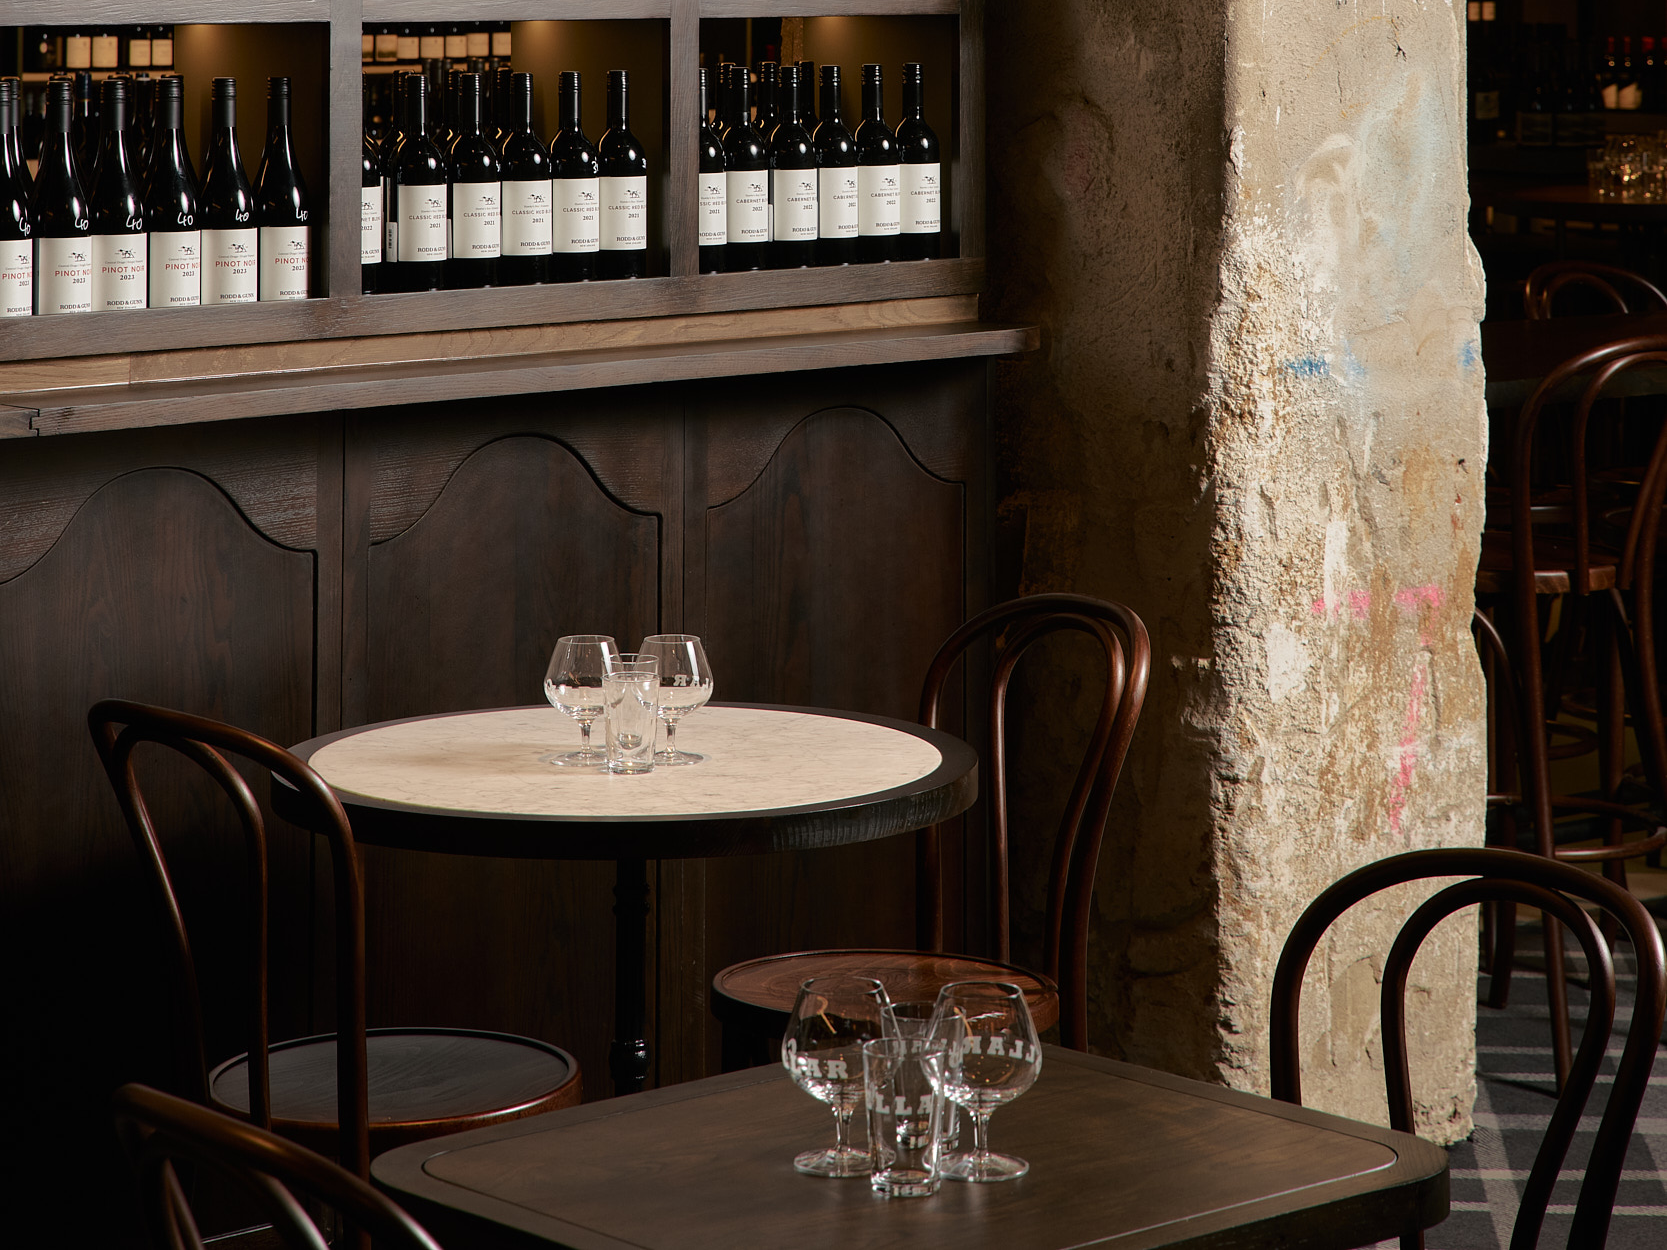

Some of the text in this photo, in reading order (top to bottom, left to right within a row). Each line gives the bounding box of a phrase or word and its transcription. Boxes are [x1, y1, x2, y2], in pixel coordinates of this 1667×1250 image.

[177, 212, 193, 226] 40
[236, 209, 249, 222] 40
[296, 208, 308, 221] 40
[75, 216, 88, 230] 40
[126, 215, 142, 230] 40
